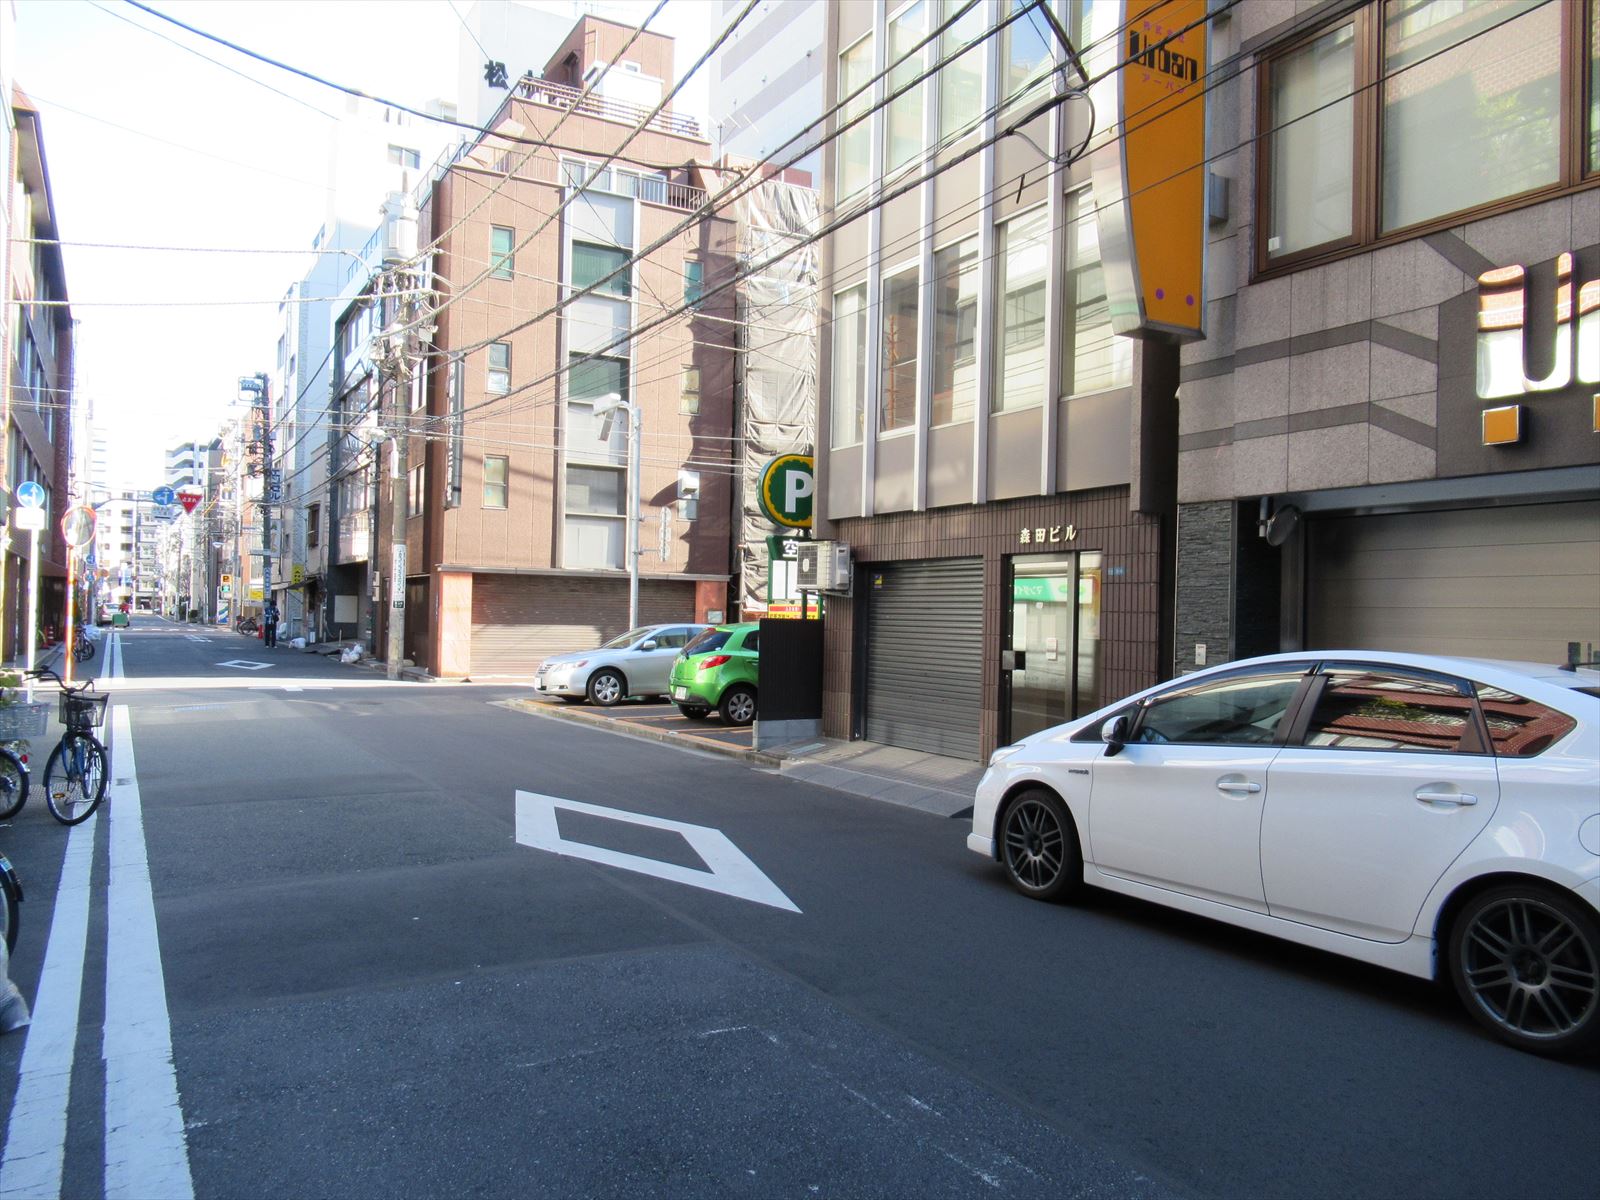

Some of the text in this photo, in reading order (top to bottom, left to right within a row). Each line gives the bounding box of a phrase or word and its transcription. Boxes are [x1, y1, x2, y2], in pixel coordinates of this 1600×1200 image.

[1130, 30, 1197, 82] Urban
[784, 469, 813, 513] P
[1020, 524, 1077, 544] 森田ビル
